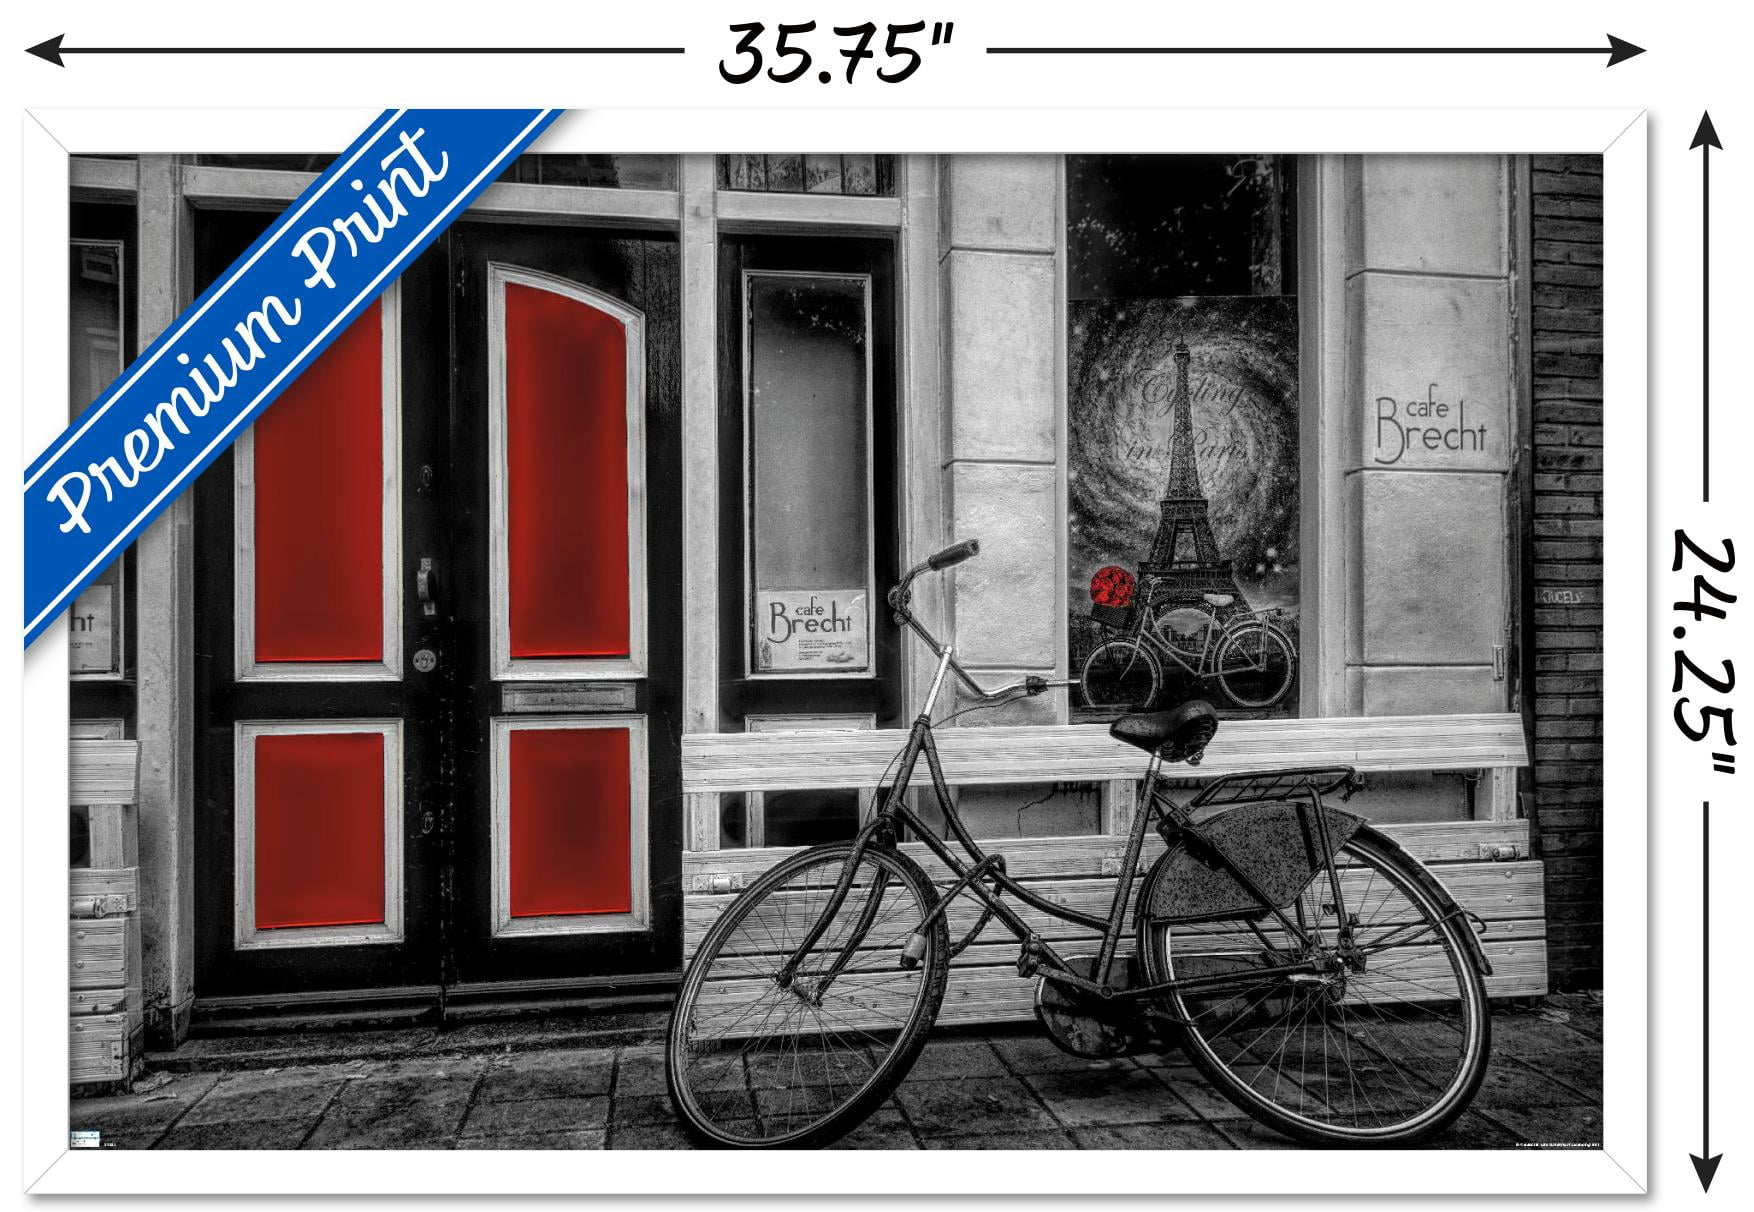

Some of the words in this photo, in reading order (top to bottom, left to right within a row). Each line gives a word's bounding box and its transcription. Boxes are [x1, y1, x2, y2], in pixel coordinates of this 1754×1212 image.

[1134, 368, 1245, 417] Cyling
[1406, 383, 1449, 418] cafe
[1374, 397, 1488, 465] Brecht
[767, 600, 852, 644] Brecht
[795, 595, 825, 616] cafe
